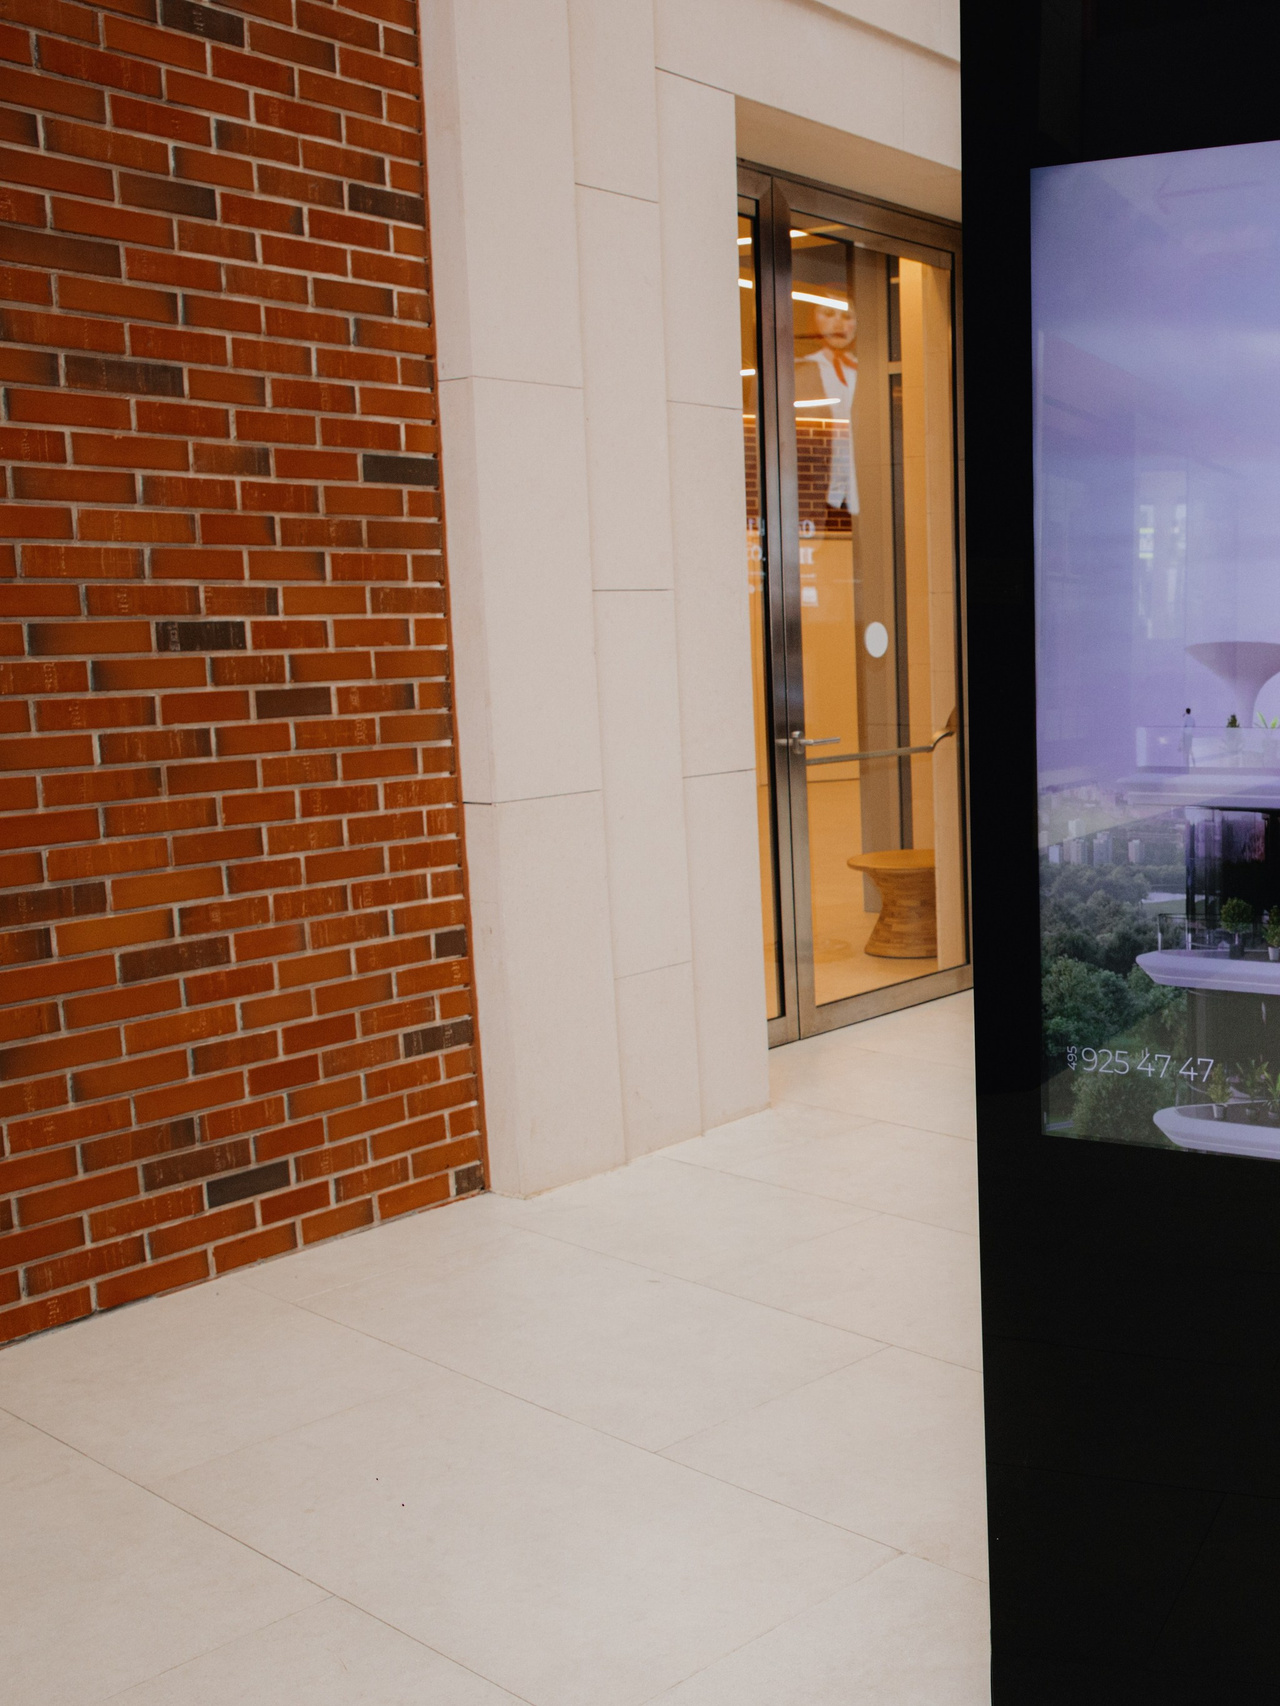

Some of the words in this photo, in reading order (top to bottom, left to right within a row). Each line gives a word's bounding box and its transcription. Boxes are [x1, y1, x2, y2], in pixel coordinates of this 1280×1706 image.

[1066, 1045, 1078, 1071] 495
[1081, 1047, 1130, 1075] 925
[1136, 1053, 1172, 1079] 47
[1178, 1056, 1215, 1083] 47
